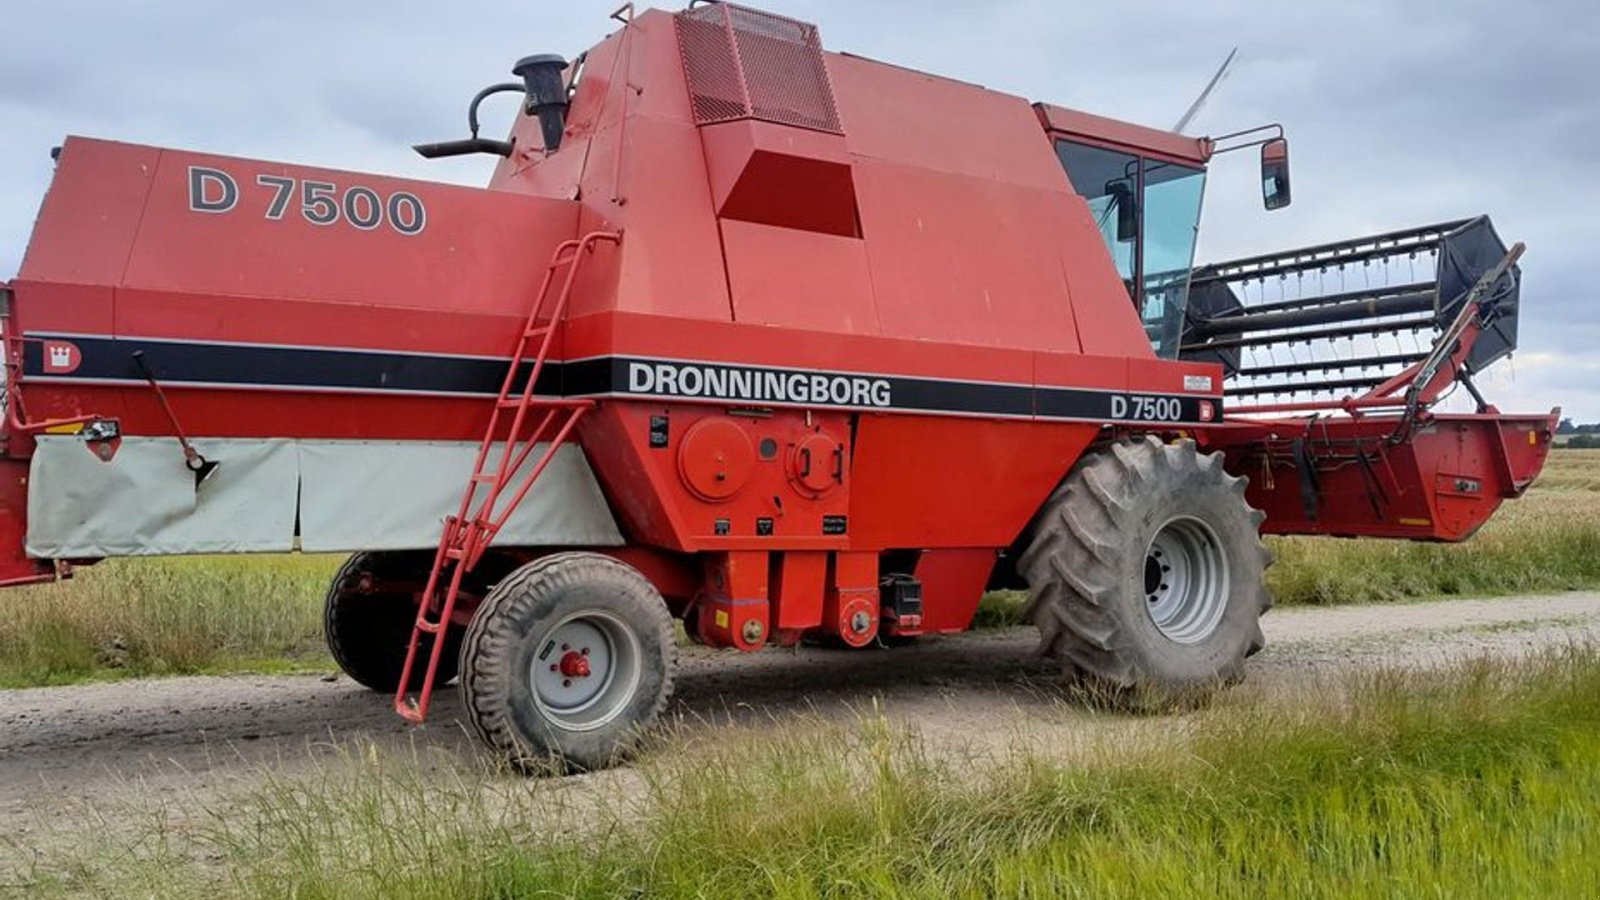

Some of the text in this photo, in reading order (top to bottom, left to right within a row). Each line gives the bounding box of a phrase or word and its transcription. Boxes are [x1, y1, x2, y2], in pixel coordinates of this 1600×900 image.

[188, 165, 427, 236] D 7500
[628, 362, 891, 406] DRONNINGBORG
[1111, 395, 1182, 421] D 7500
